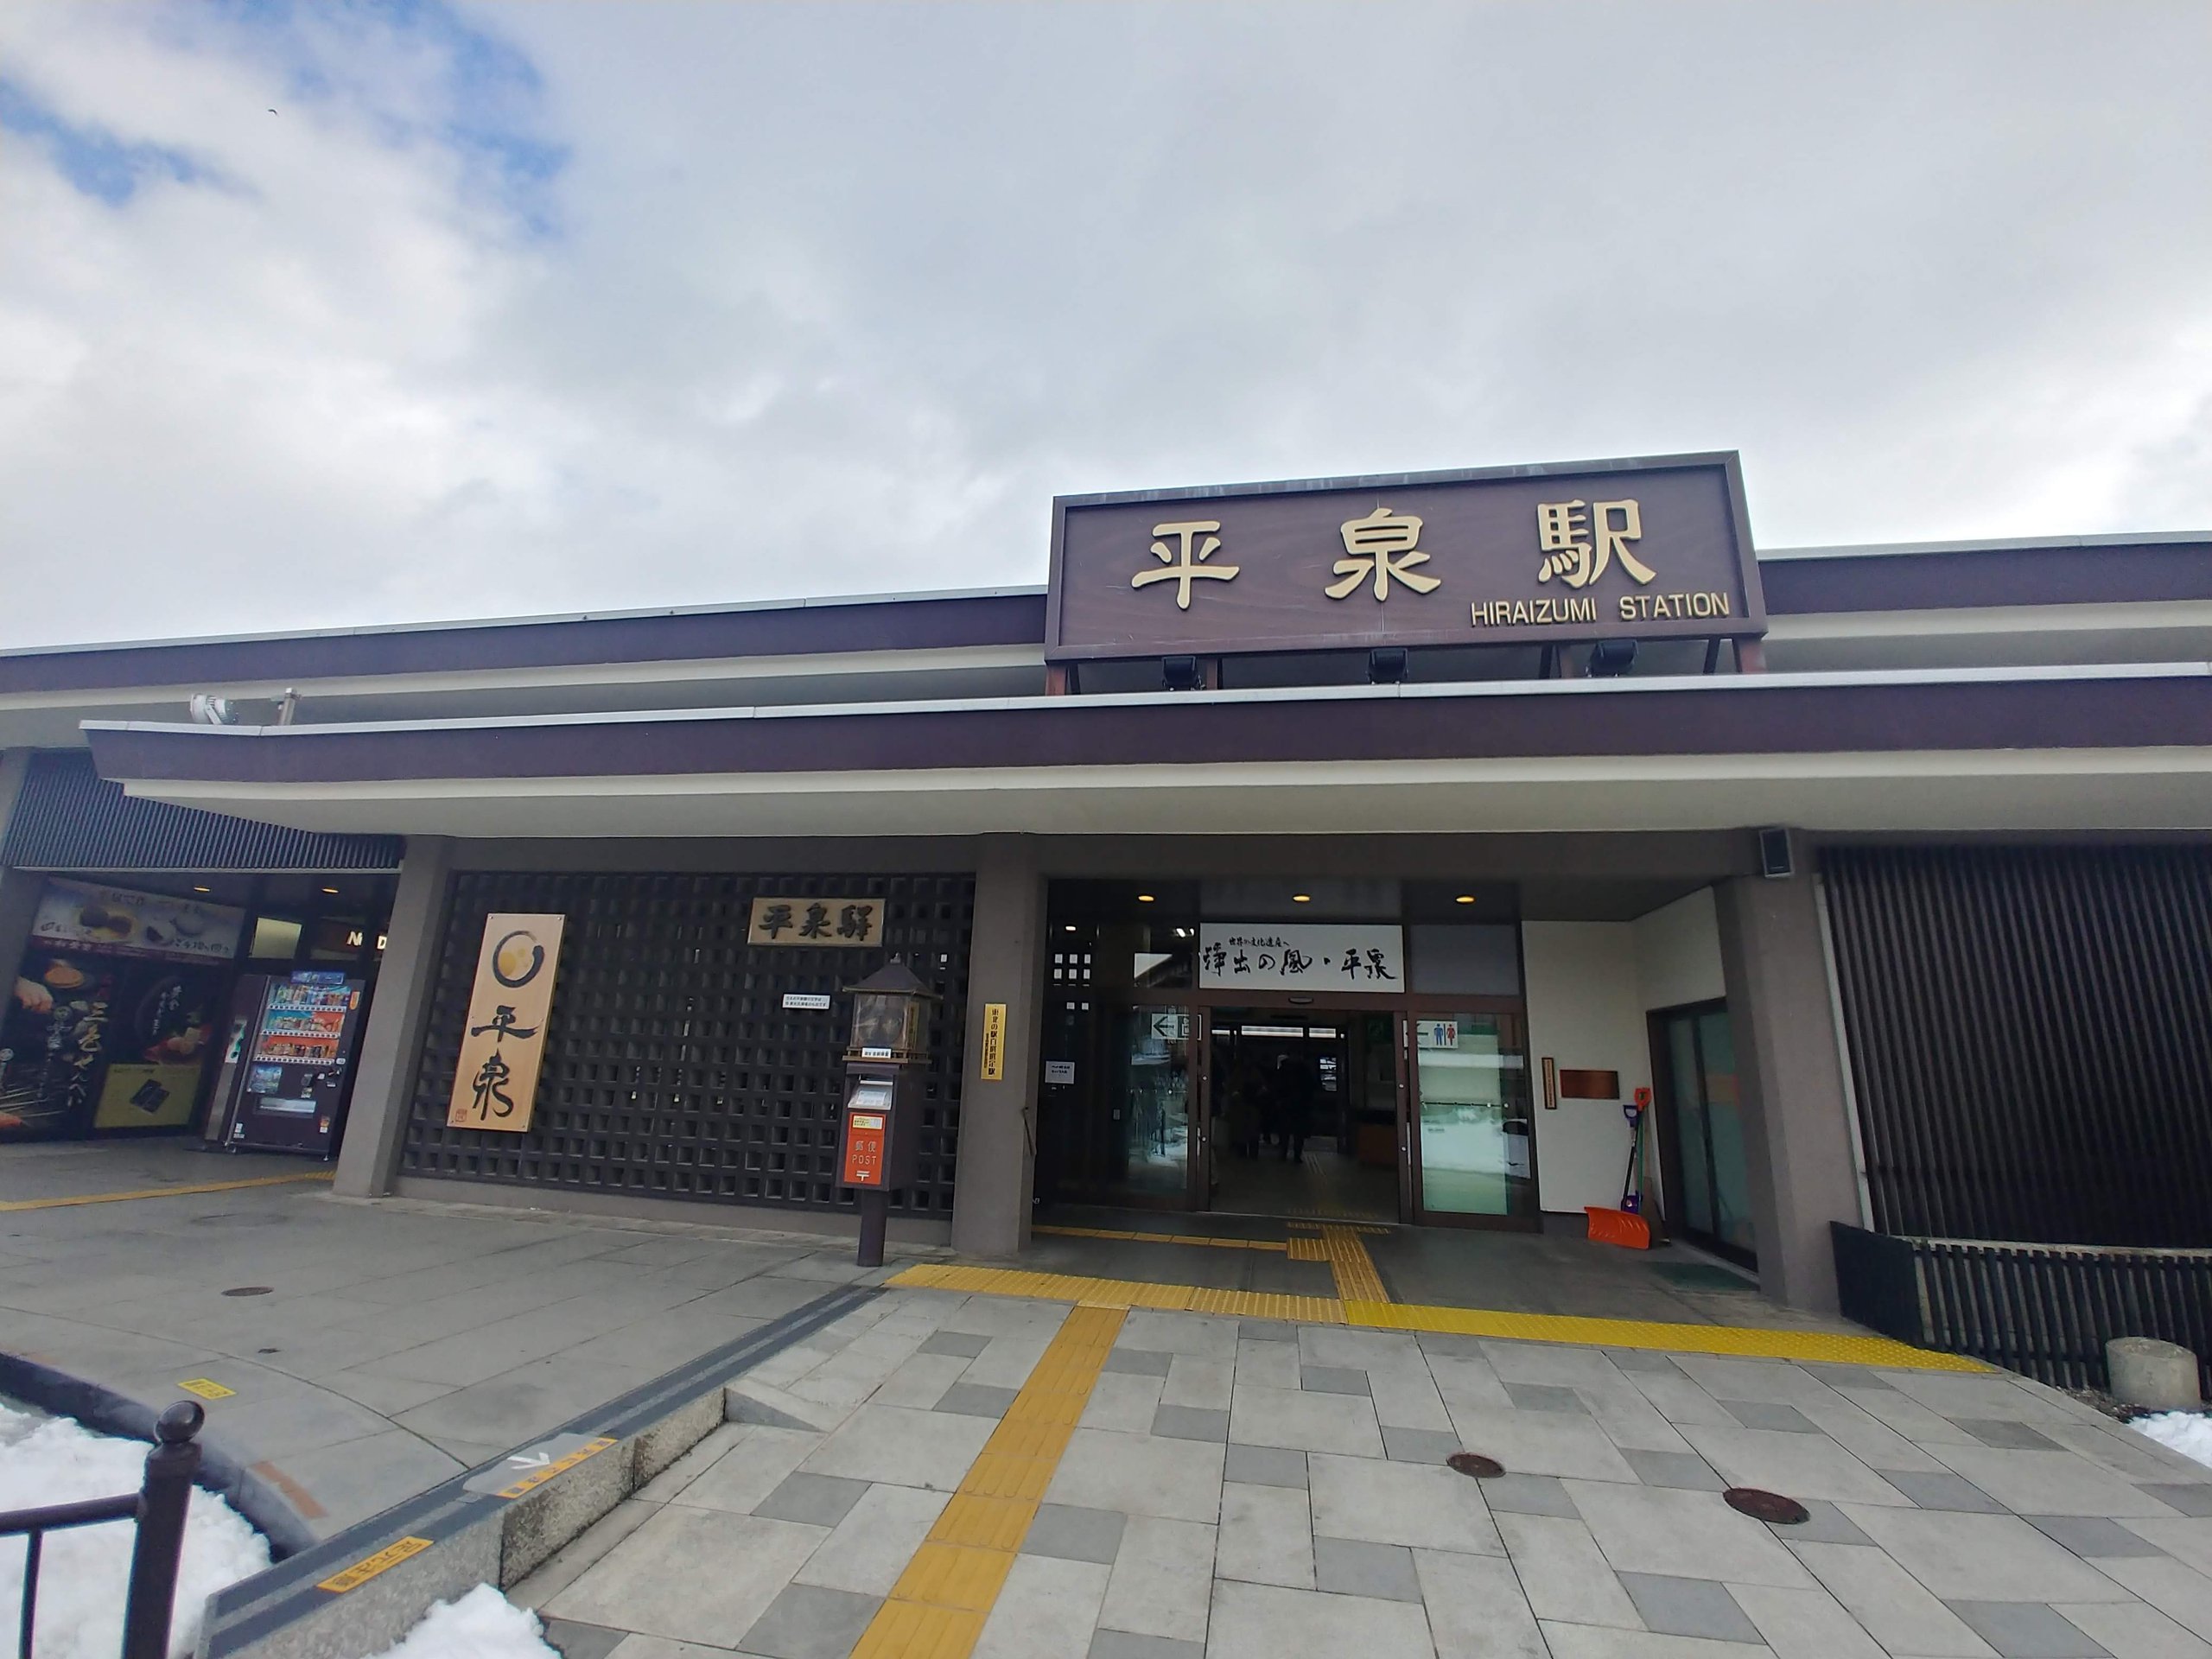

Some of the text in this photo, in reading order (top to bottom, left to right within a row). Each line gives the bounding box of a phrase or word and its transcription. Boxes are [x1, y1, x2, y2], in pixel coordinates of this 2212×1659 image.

[1130, 499, 1657, 610] 平泉駅
[1470, 589, 1731, 628] HIRAIZUMI STATION
[471, 1004, 541, 1121] 平泉
[851, 1154, 877, 1166] POST
